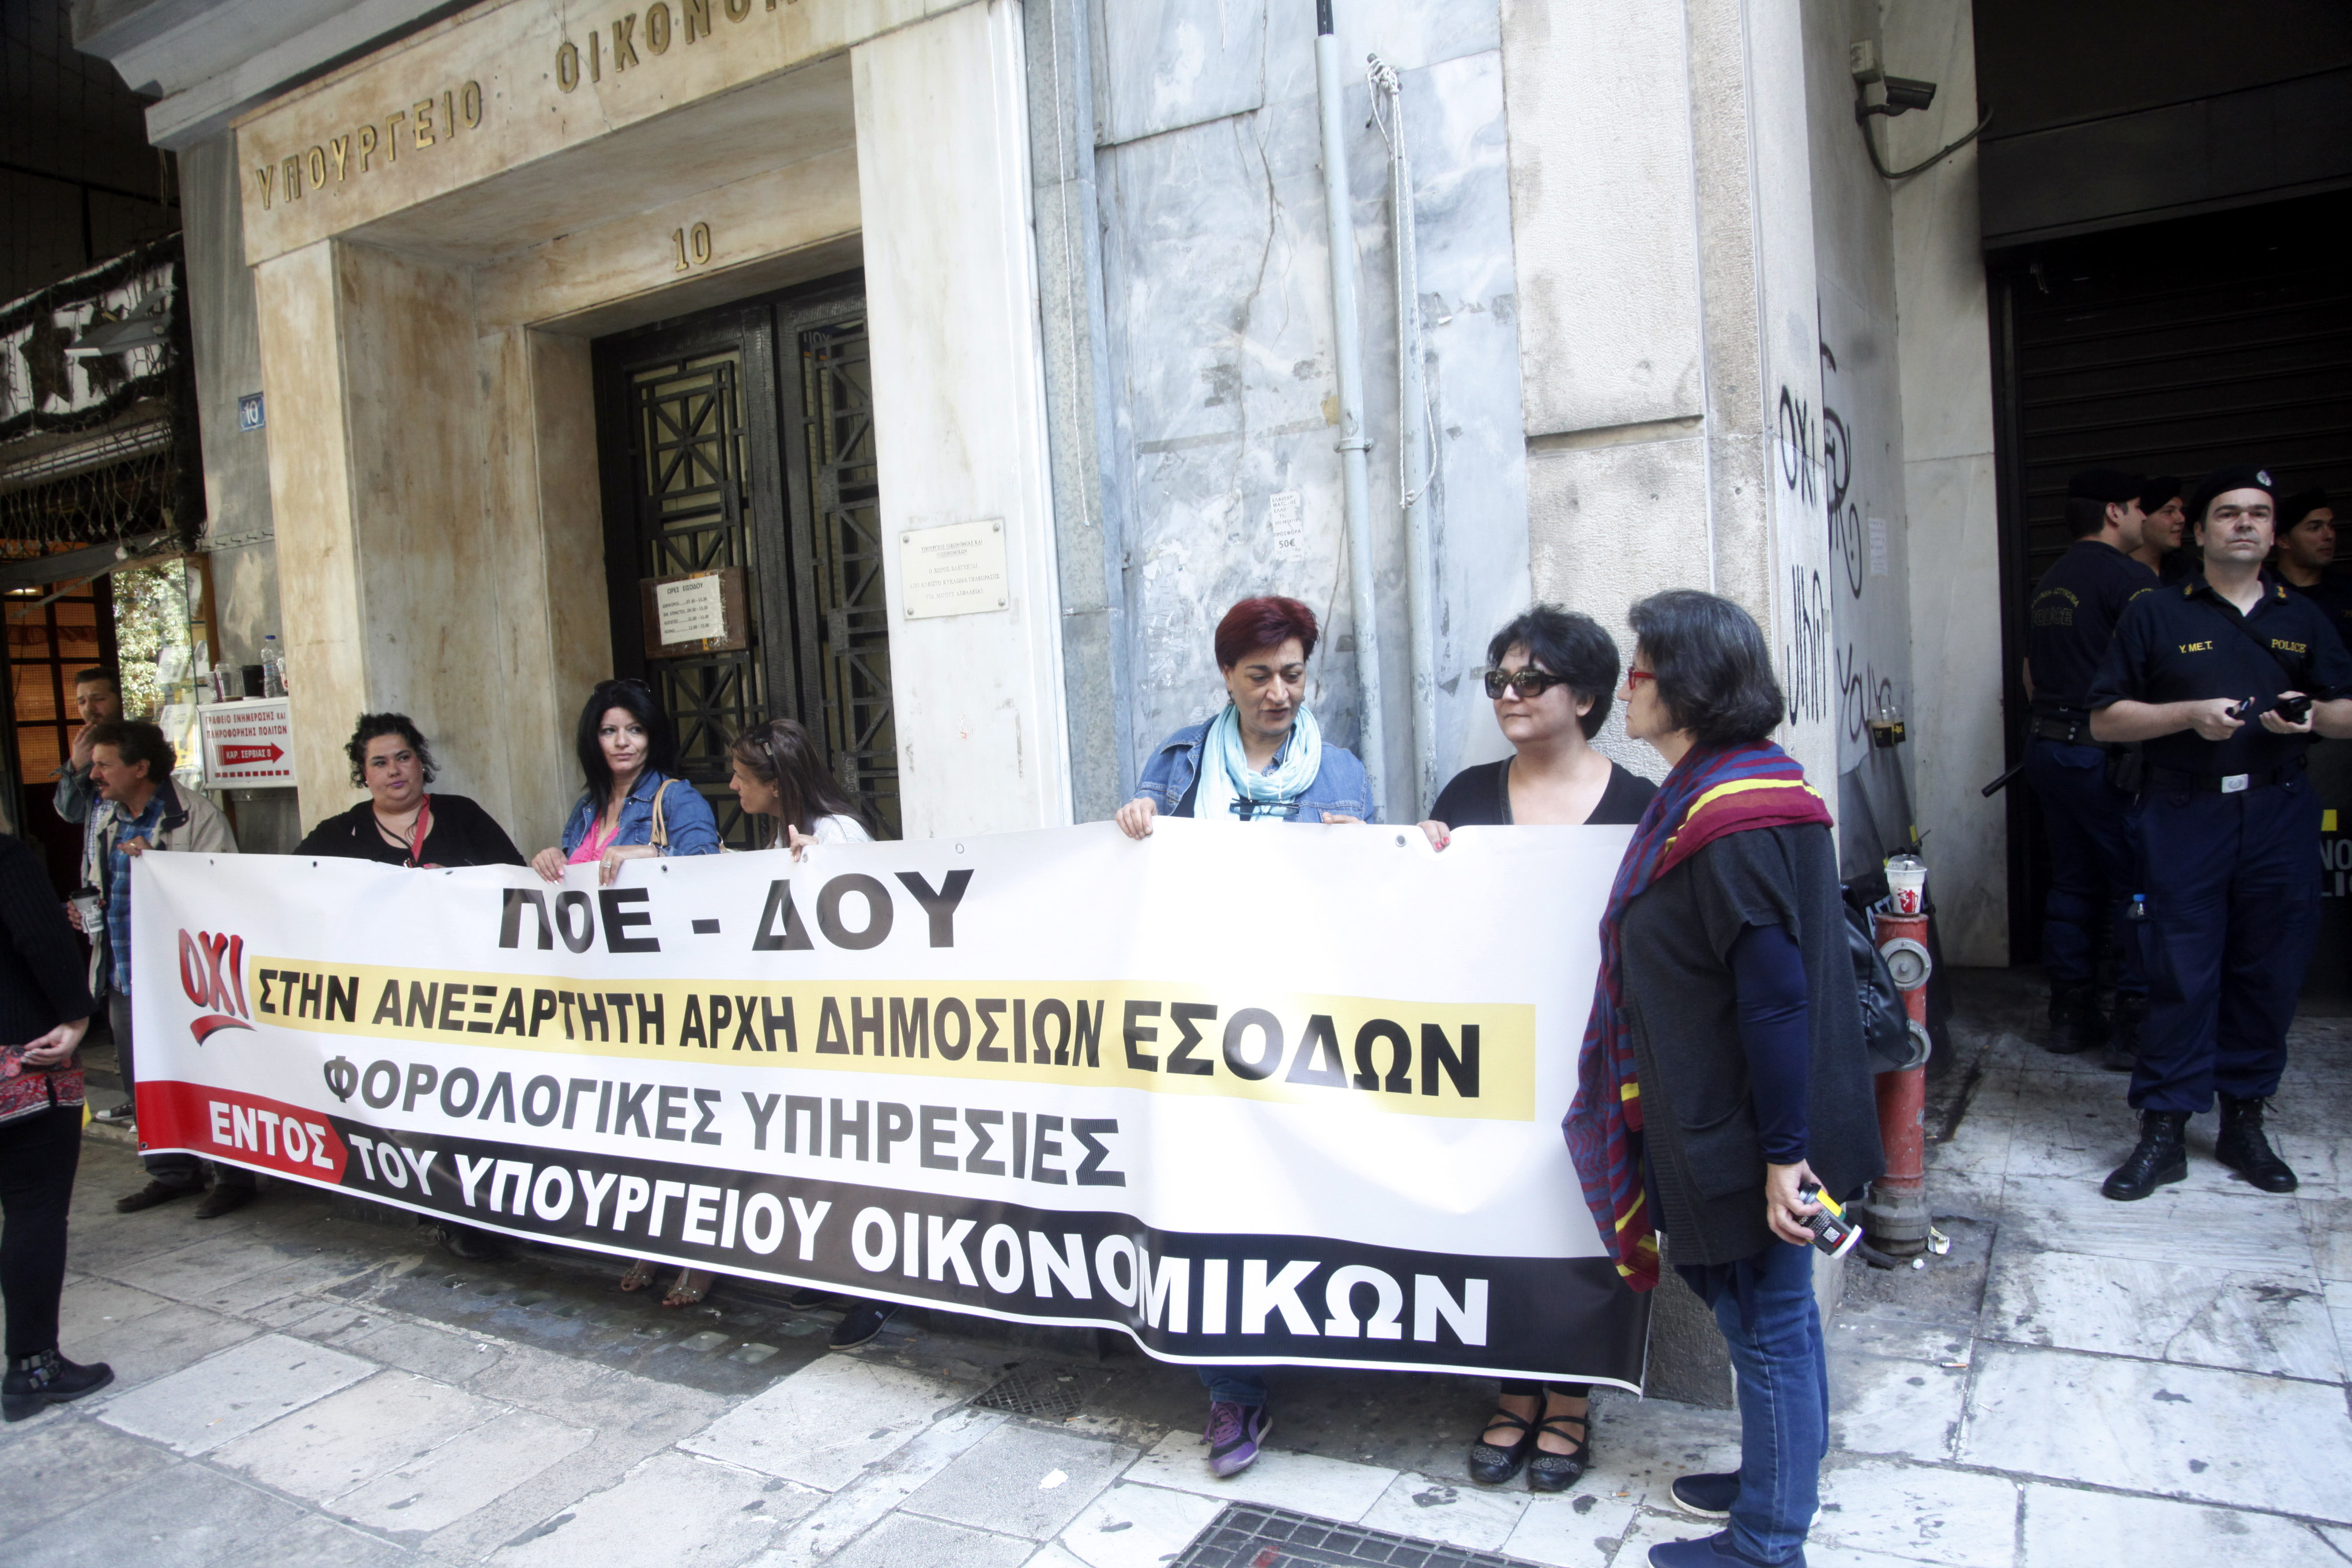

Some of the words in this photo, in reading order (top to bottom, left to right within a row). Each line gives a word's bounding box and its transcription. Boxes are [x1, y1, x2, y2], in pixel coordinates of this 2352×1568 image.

[255, 80, 483, 210] ΥΠΟΥΡΓΕΙΟ
[555, 0, 798, 93] ΟΙΚΟΝ
[672, 221, 711, 272] 10
[244, 400, 258, 424] 10
[1780, 385, 1816, 508] ΟΧΙ
[1273, 529, 1301, 537] ΠΡΟΣΦΟΡΑ
[921, 544, 945, 552] ΥΠΟΥΡΓΕΙΟ
[946, 540, 974, 549] ΟΙΚΟΝΟΜΙΑΣ
[1279, 538, 1295, 548] 50€
[934, 566, 950, 574] ΧΩΡΟΣ
[951, 563, 978, 571] ΕΛΕΓΧΕΤΑΙ
[943, 577, 967, 585] ΚΥΚΛΩΜΑ
[968, 574, 1000, 582] ΤΗΛΕΟΡΑΣΗΣ
[667, 586, 679, 594] ΩΡΕΣ
[683, 582, 703, 591] ΕΙΣΟΔΟΥ
[2271, 639, 2306, 653] POLICE
[205, 714, 231, 725] ΓΡΑΦΕΙΟ
[233, 711, 274, 723] ΕΝΗΜΕΡΩΣΗΣ
[206, 727, 257, 738] ΠΛΗΡΟΦΟΡΗΣΗΣ
[258, 725, 287, 735] ΠΟΛΙΤΩΝ
[241, 749, 266, 759] ΣΕΡΒΙΑΣ
[267, 749, 271, 757] 8
[499, 887, 661, 954] ΠΟΕ
[752, 869, 974, 951] ΔΟΥ
[178, 928, 248, 1020] ΟΧΙ
[258, 968, 359, 1023] ΣΤΗΝ
[372, 979, 665, 1046] ΑΝΕΞΑΡΤΗΤΗ
[679, 994, 798, 1053] ΑΡΧΗ
[815, 997, 1105, 1068] ΔΗΜΟΣΙΩΝ
[1123, 1000, 1479, 1098] ΕΣΟΔΩΝ
[323, 1056, 722, 1145] ΦΟΡΟΛΟΓΙΚΕΣ
[741, 1091, 1126, 1188] ΥΠΗΡΕΣΙΕΣ
[209, 1100, 334, 1169] ΕΝΤΟΣ
[348, 1133, 437, 1196] ΤΟΥ
[455, 1153, 832, 1261] ΥΠΟΥΡΓΕΙΟΥ
[851, 1207, 1489, 1346] ΟΙΚΟΝΟΜΙΚΩΝ
